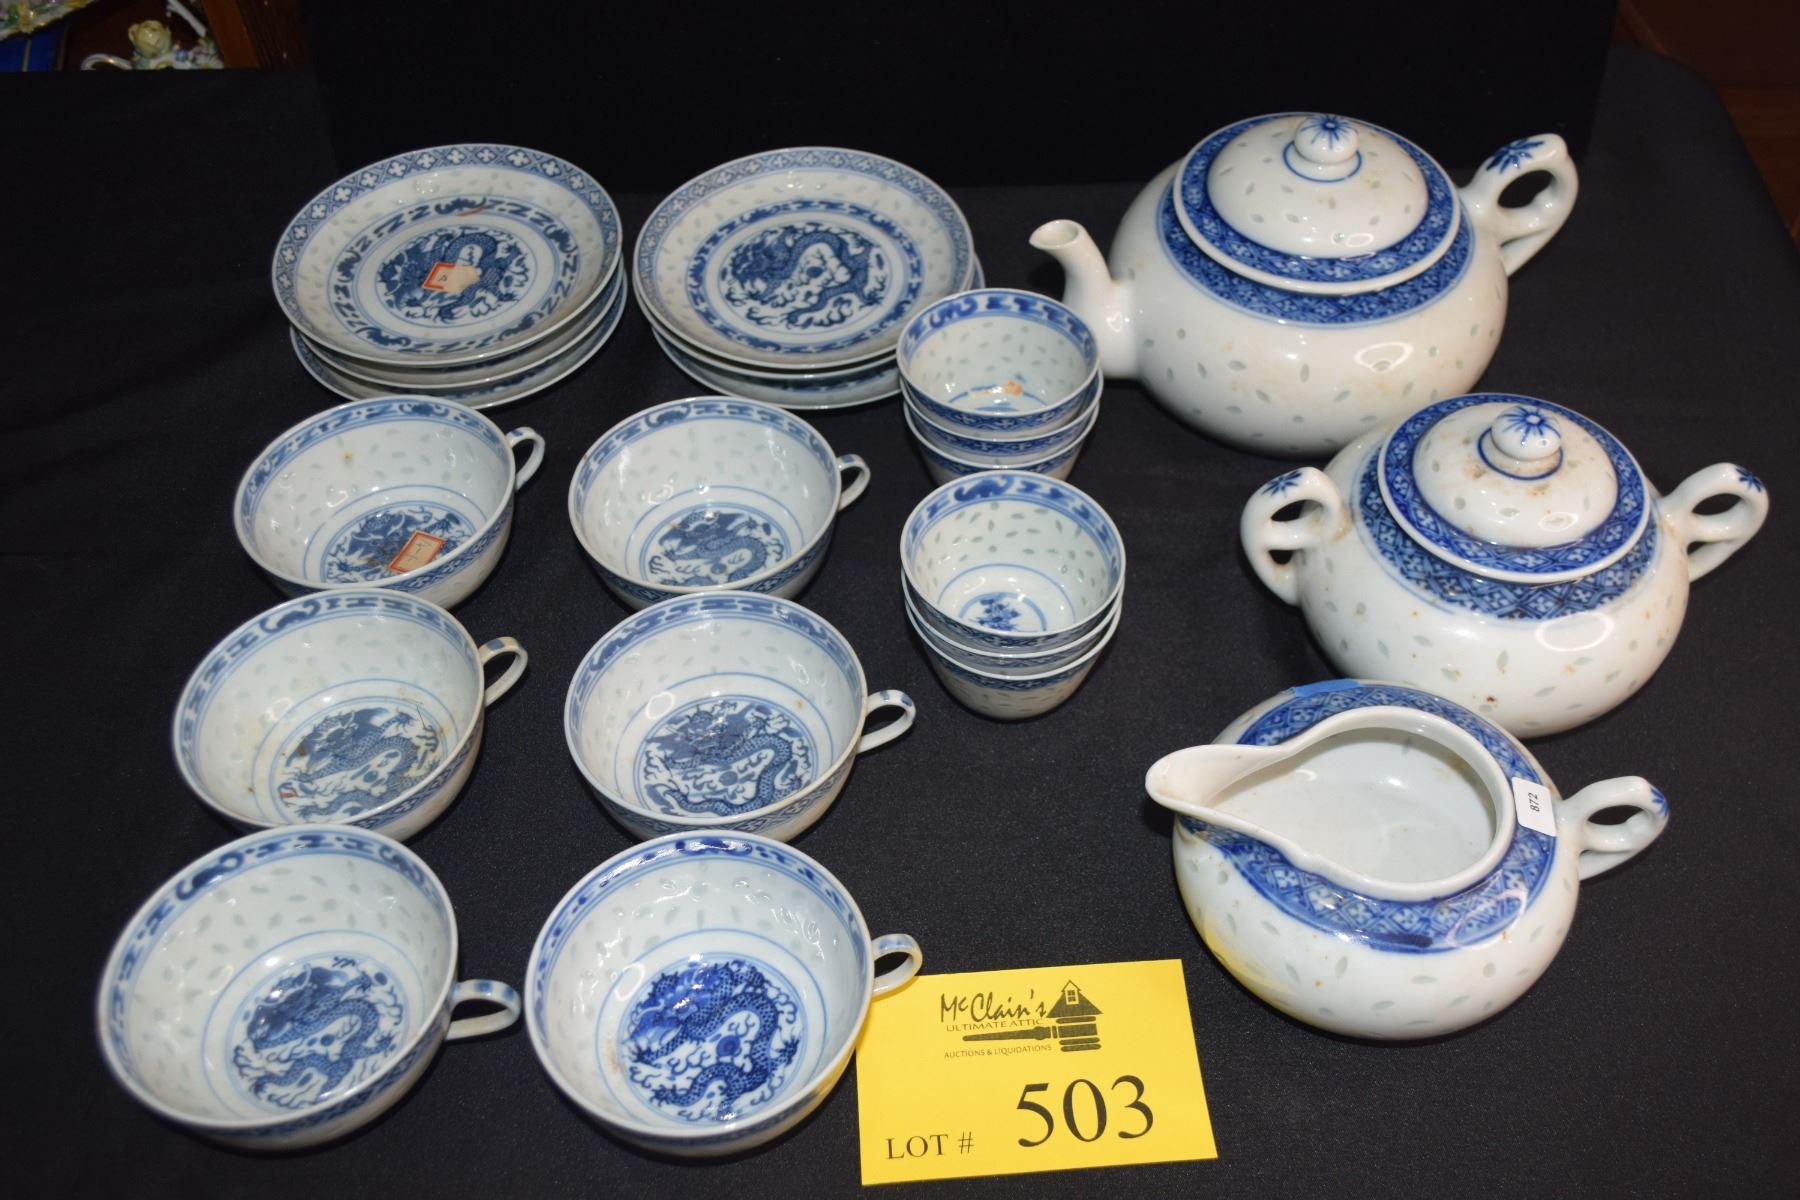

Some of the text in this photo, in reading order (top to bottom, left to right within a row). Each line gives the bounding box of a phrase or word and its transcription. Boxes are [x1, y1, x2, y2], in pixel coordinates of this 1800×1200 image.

[1528, 792, 1540, 812] 872
[940, 989, 1047, 1022] McClain's
[946, 1018, 1044, 1032] ULTIMATE ATTIC
[944, 1044, 1052, 1058] AUCTIONS & LIQUIDATIONS
[886, 1074, 1154, 1160] LOT # 503
